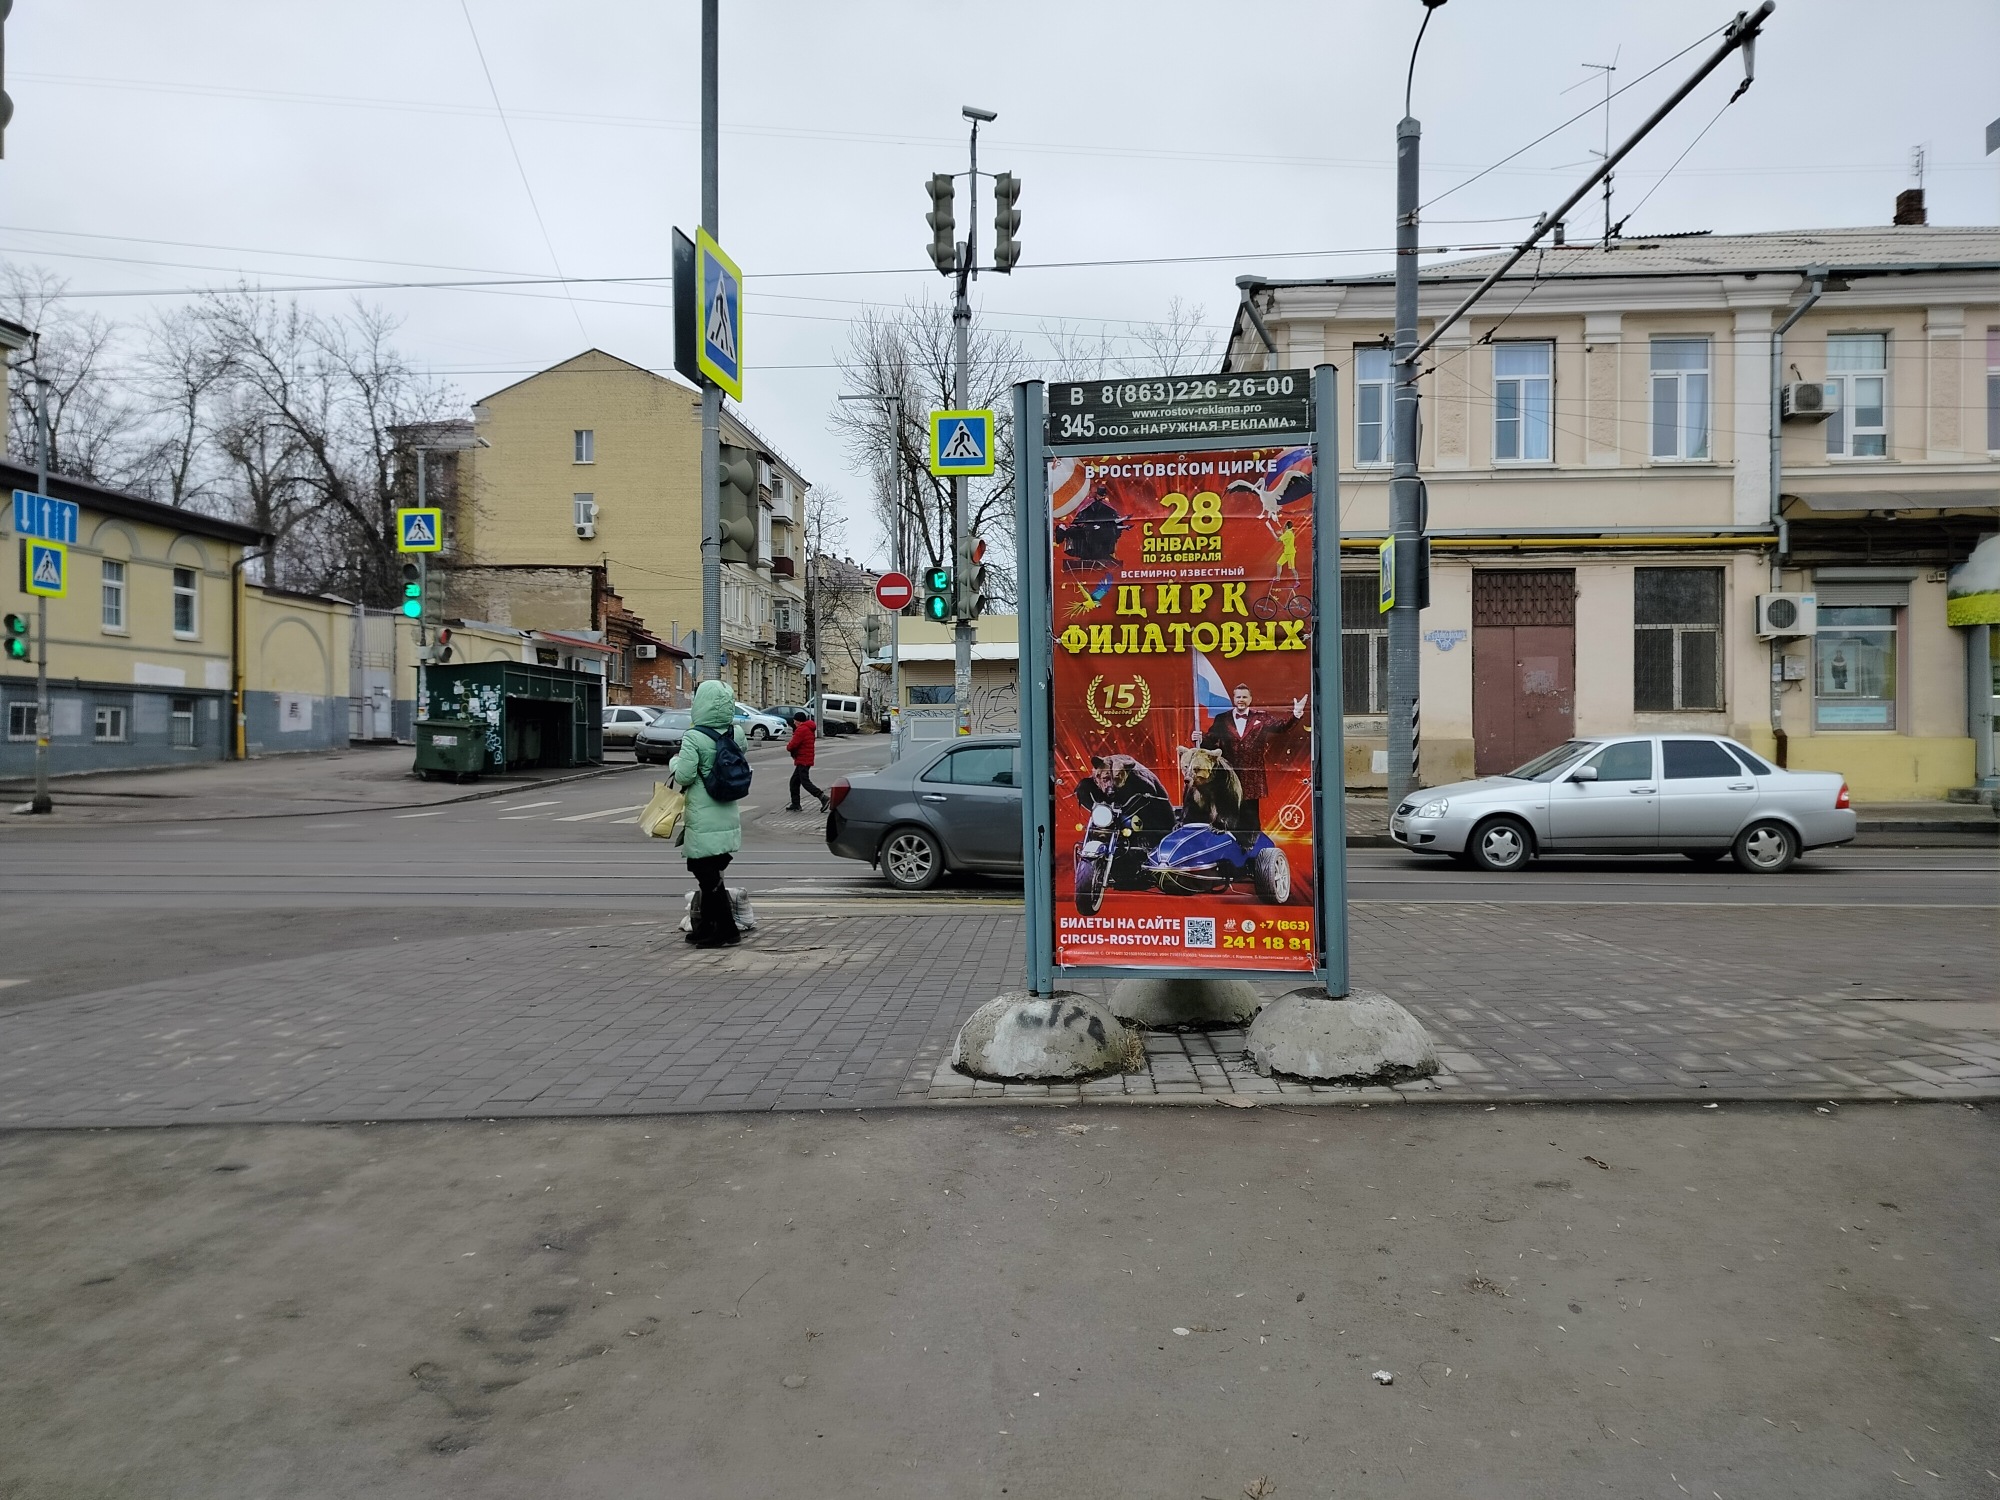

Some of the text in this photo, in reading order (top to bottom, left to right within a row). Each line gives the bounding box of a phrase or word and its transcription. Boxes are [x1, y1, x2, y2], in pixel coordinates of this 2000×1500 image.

[1101, 375, 1294, 408] 8(863)226-26-00
[1131, 404, 1262, 418] www.rostov-reklama.pro
[1060, 413, 1095, 437] 345
[1098, 416, 1297, 436] ООО «НАРУЖНАЯ РЕКЛАМА»
[1085, 459, 1278, 479] В РОСТОВСКОМ ЦИРКЕ
[1158, 491, 1223, 535] 28
[1143, 535, 1222, 552] ЯНВАРЯ
[1143, 552, 1222, 563] ПО 26 ФЕВРАЛЯ
[934, 572, 946, 588] 12
[1120, 567, 1245, 579] ВСЕМИРНО ИЗВЕСТНЫЙ
[1116, 581, 1249, 618] ЦИРК
[1060, 619, 1307, 658] ФИЛАТОВЫХ
[1103, 684, 1136, 709] 15
[1060, 916, 1181, 930] БИЛЕТЫ НА САЙТЕ
[1259, 920, 1310, 932] +7 (863)
[1060, 934, 1180, 946] CIRCUS-ROSTOV.RU
[1223, 935, 1311, 951] 241 18 81
